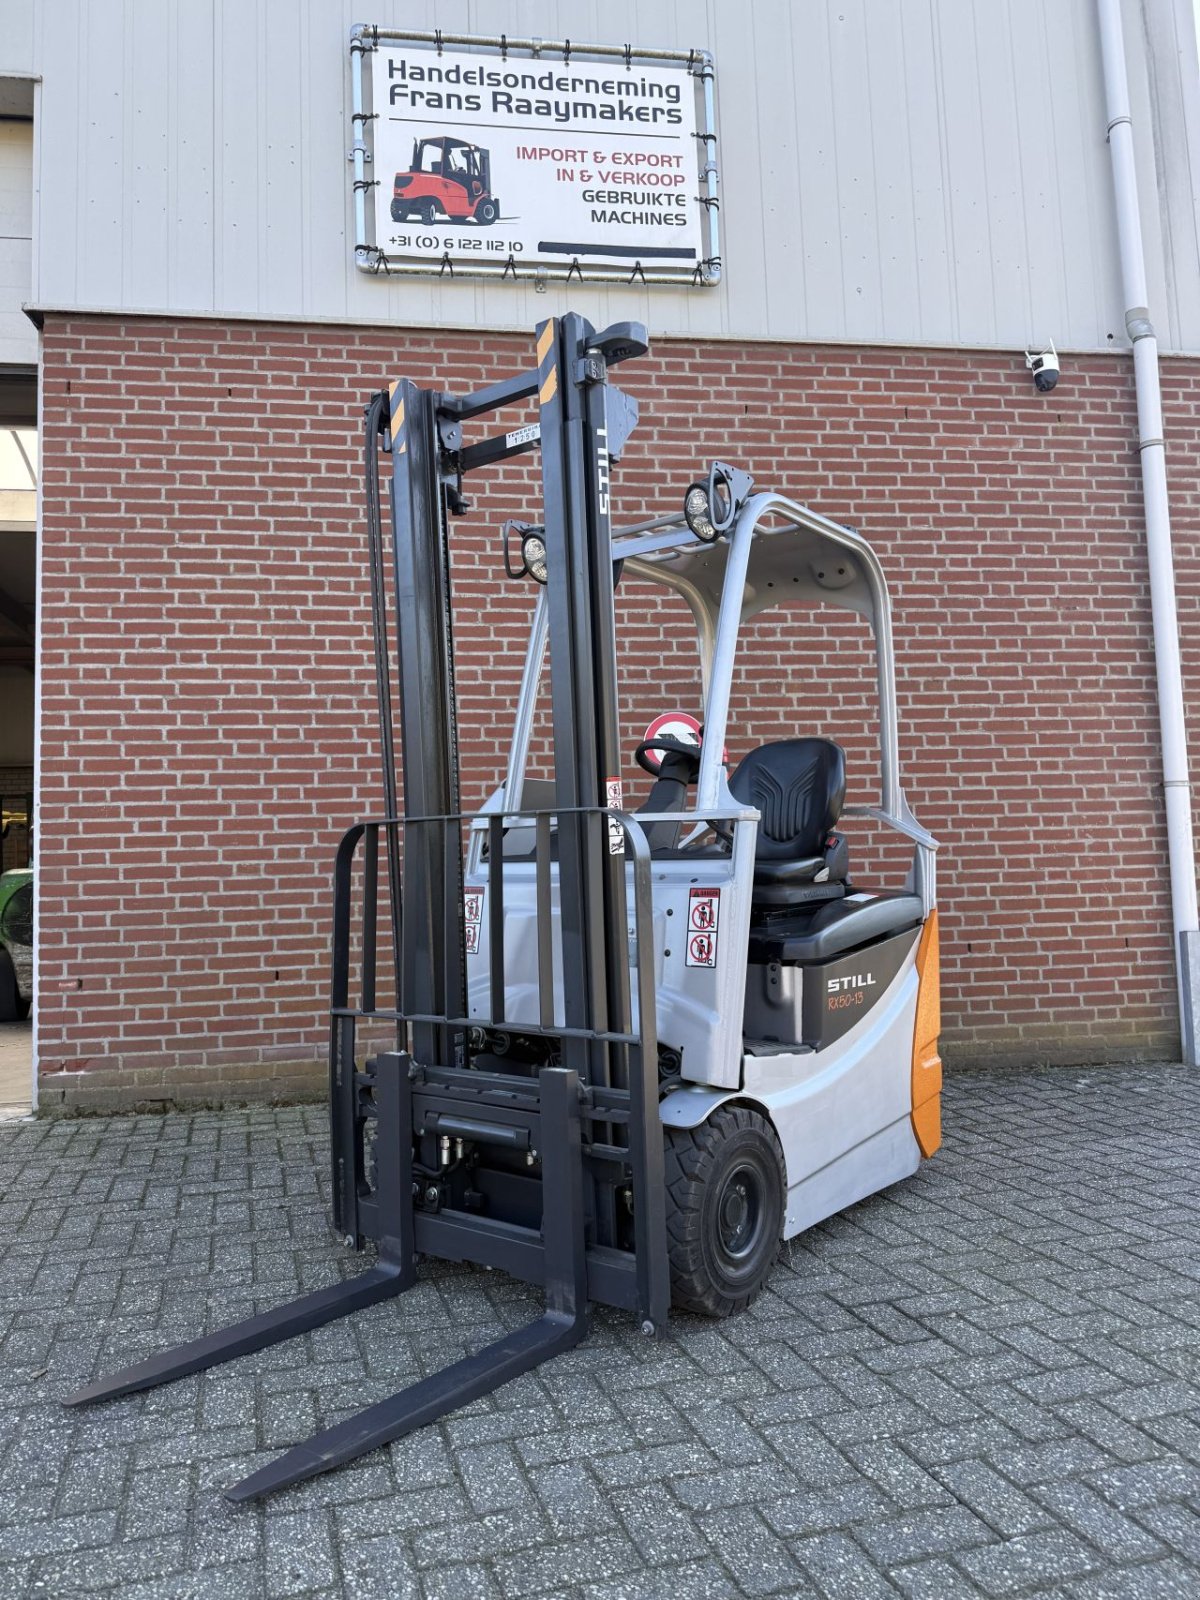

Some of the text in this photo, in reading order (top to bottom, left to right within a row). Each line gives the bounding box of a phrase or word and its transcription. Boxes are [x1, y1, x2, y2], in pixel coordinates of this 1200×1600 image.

[388, 58, 681, 104] Handelsonderneming
[389, 83, 683, 125] Frans Raaymakers
[516, 146, 684, 169] IMPORT & EXPORT
[556, 168, 686, 187] IN & VERKOOP
[582, 189, 687, 207] GEBRUIKTE
[591, 209, 688, 227] MACHINES
[389, 235, 524, 252] +31 (0) 6 122 112 10
[596, 428, 609, 515] STILL
[827, 972, 877, 993] STILL
[827, 991, 864, 1011] RX50-13
